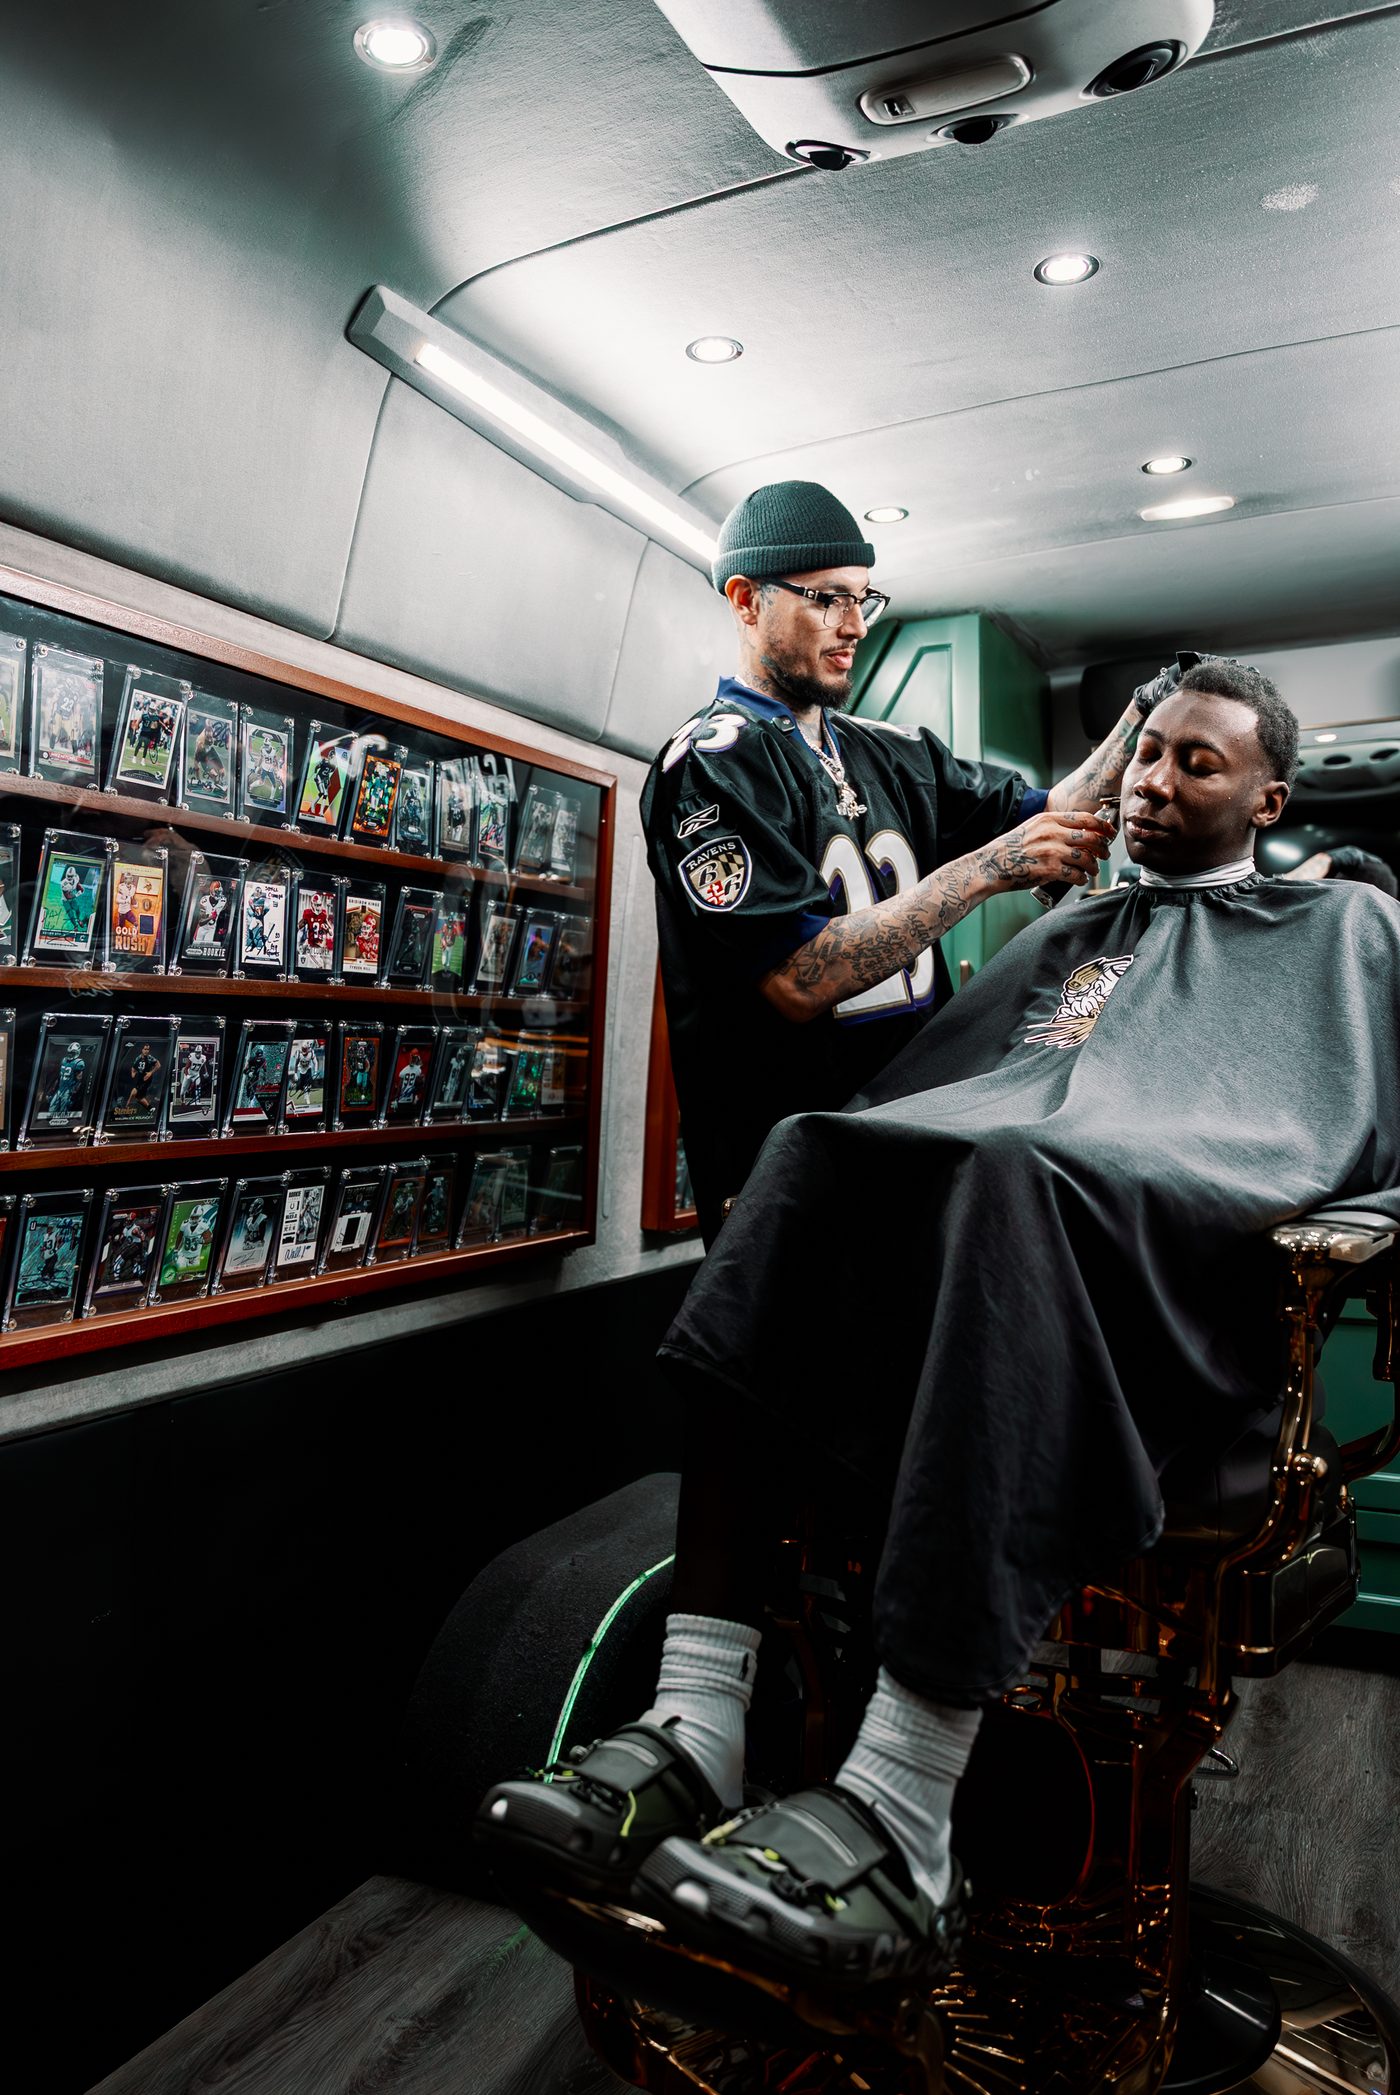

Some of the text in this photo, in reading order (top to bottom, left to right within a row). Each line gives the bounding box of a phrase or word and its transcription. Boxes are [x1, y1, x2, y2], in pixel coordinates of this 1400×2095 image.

[686, 842, 737, 871] RAVENS
[115, 926, 138, 937] GOLD
[115, 936, 146, 951] RUSH
[202, 947, 227, 957] ROOKIE
